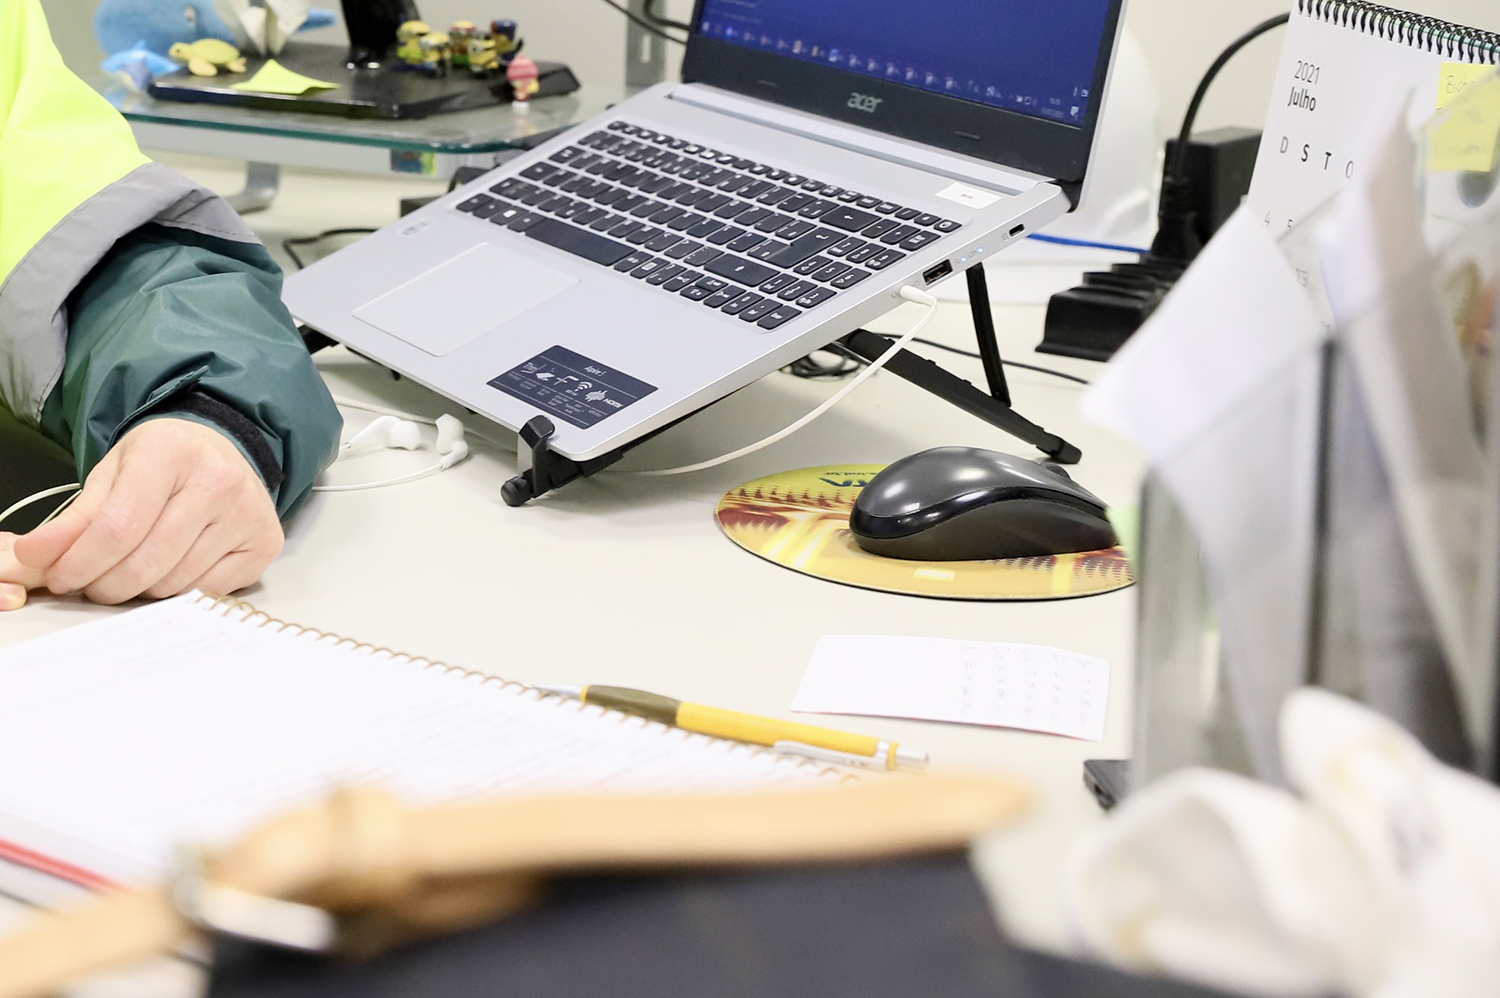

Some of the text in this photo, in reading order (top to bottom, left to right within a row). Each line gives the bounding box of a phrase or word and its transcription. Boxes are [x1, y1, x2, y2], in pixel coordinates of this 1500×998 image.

[1294, 60, 1321, 85] 2021
[846, 90, 882, 114] acer
[1287, 86, 1316, 112] Julho
[1280, 136, 1288, 155] D
[1301, 144, 1309, 162] S
[1323, 151, 1332, 171] T
[1264, 211, 1271, 227] 4
